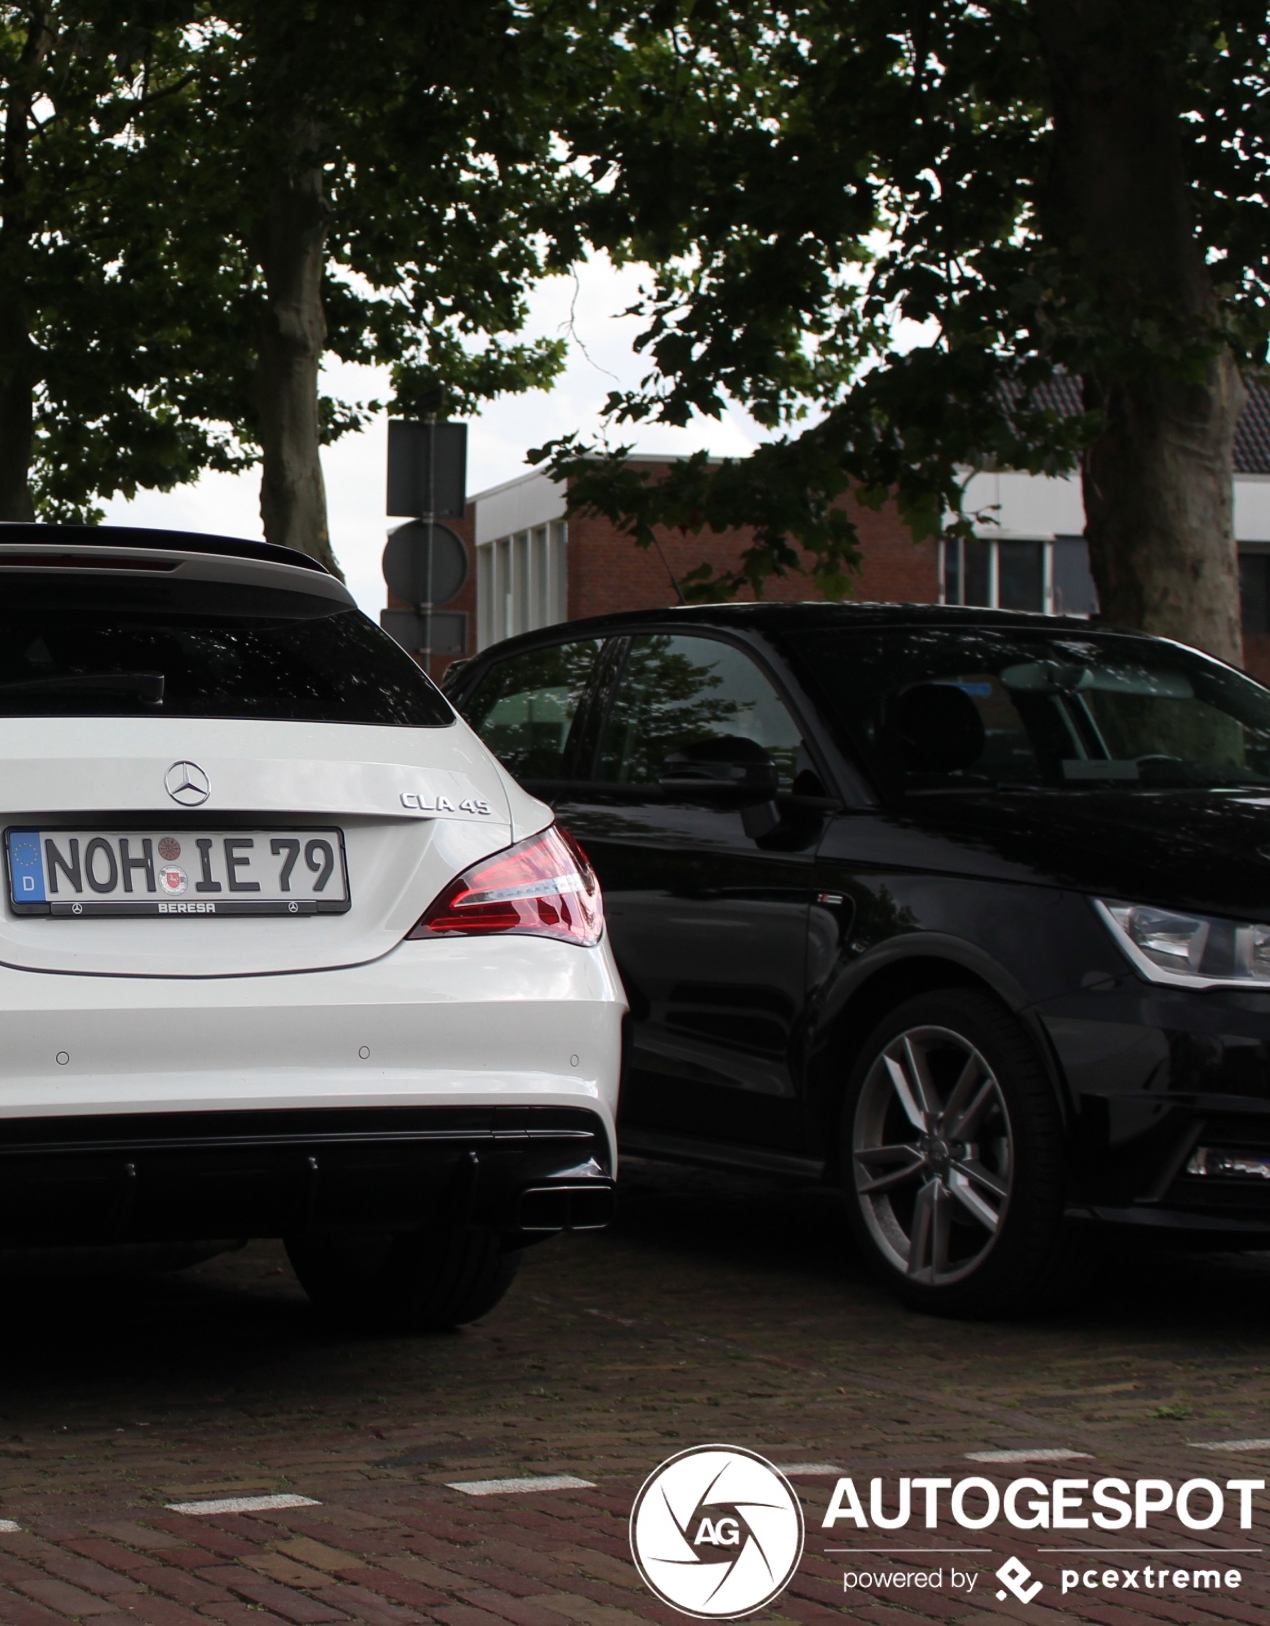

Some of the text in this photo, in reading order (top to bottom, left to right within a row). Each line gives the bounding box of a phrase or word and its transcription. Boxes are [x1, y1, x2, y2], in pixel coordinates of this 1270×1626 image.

[400, 792, 492, 816] CLA 45
[45, 837, 157, 893] NOH
[196, 838, 261, 892] IE
[270, 838, 335, 892] 79
[22, 876, 35, 891] D
[158, 903, 216, 913] BERESA
